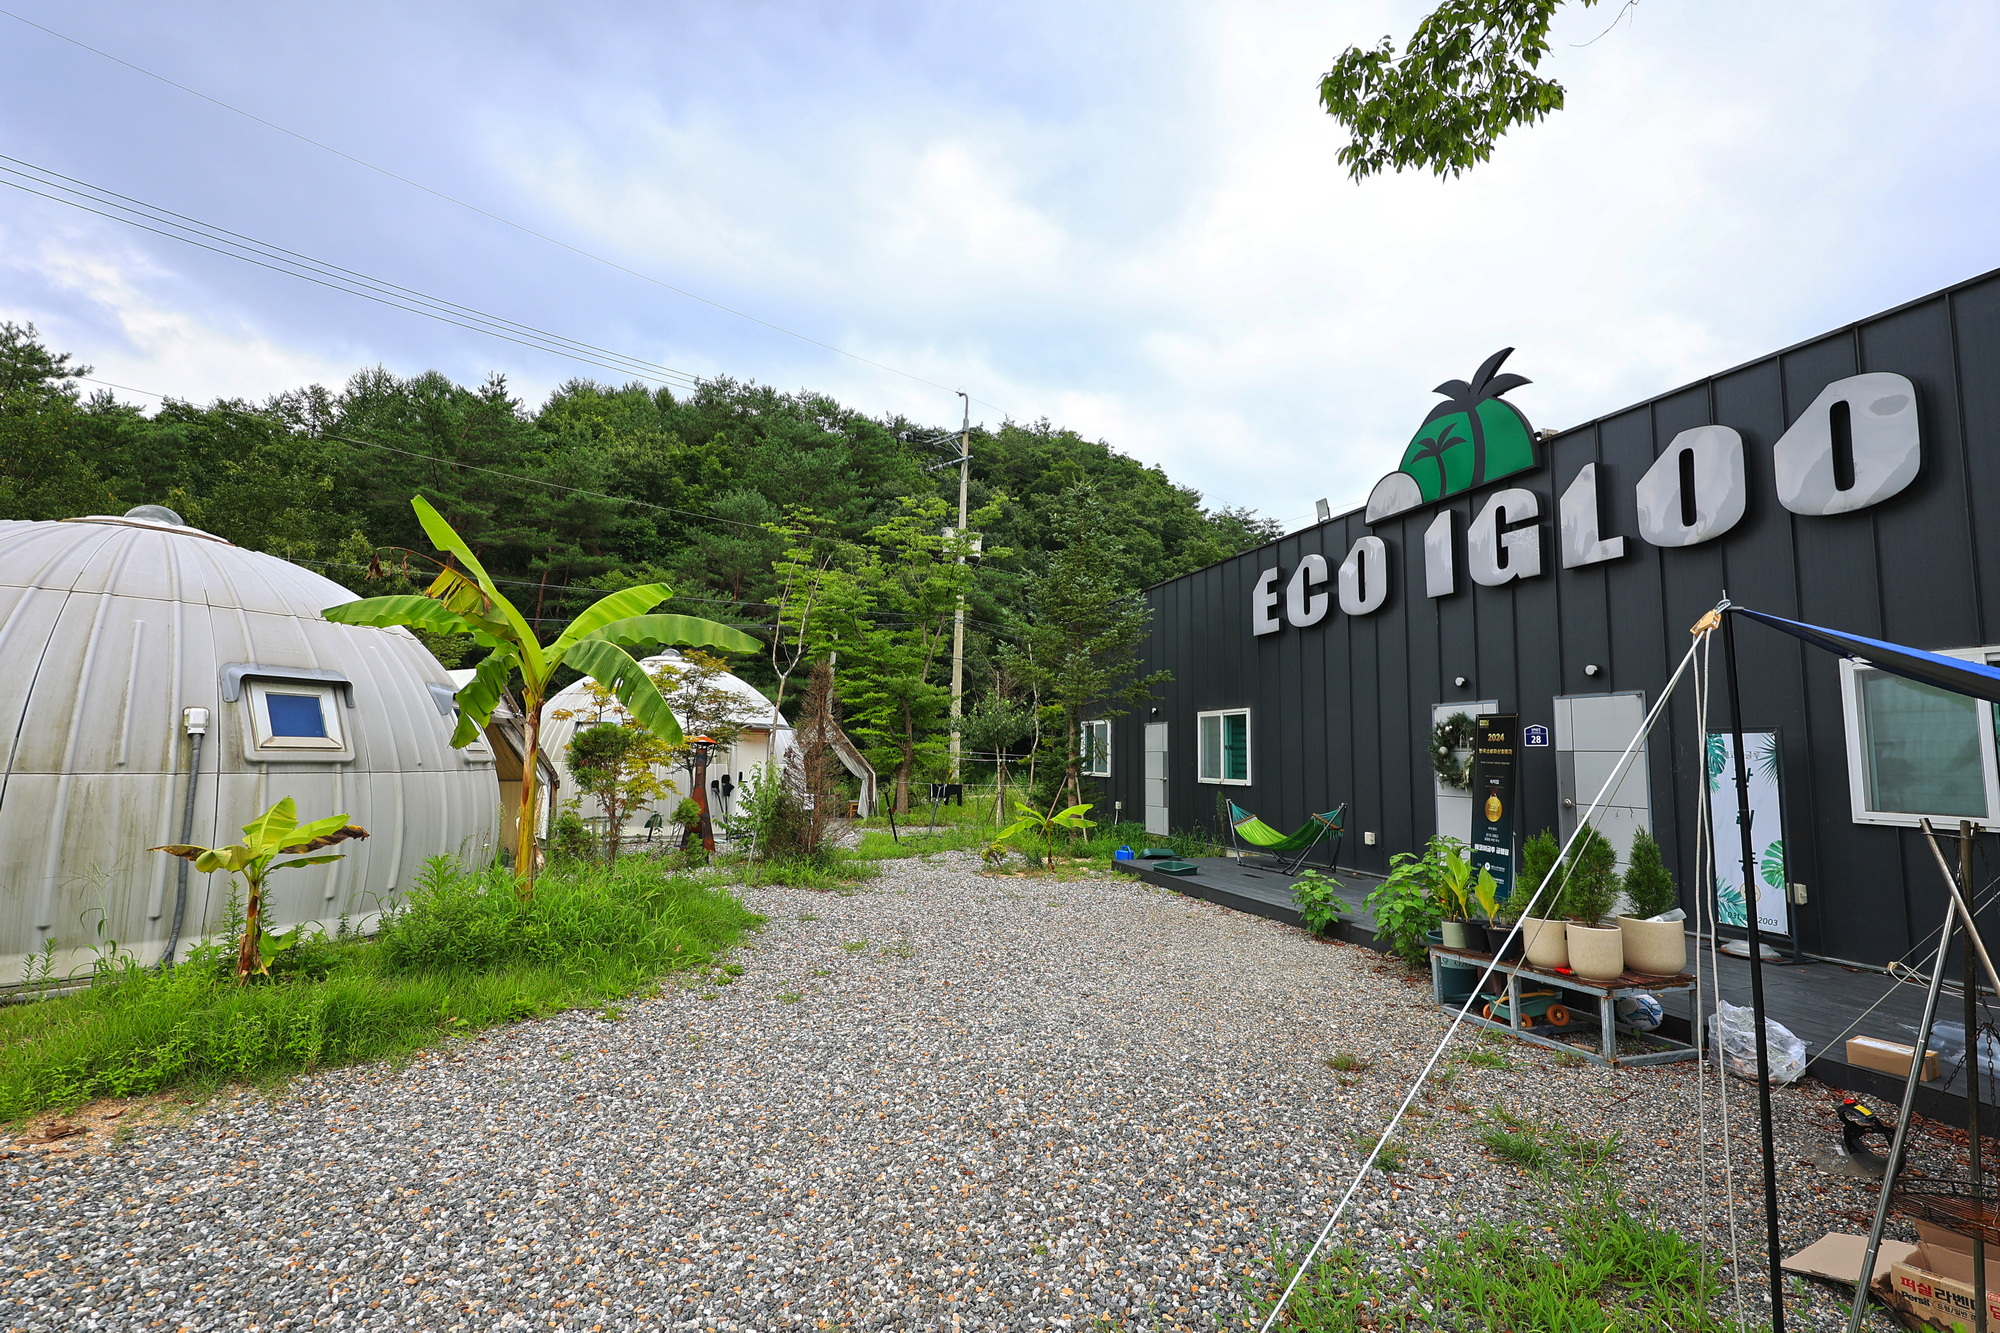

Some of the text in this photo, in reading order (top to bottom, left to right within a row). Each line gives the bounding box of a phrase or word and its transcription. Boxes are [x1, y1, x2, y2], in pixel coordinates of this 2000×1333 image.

[1252, 371, 1922, 637] ECO IGLOO
[1487, 733, 1505, 742] 2024
[1531, 735, 1541, 744] 28
[1758, 916, 1778, 927] 2003
[1900, 1276, 1933, 1298] 퍼실
[1901, 1290, 1930, 1307] Persil
